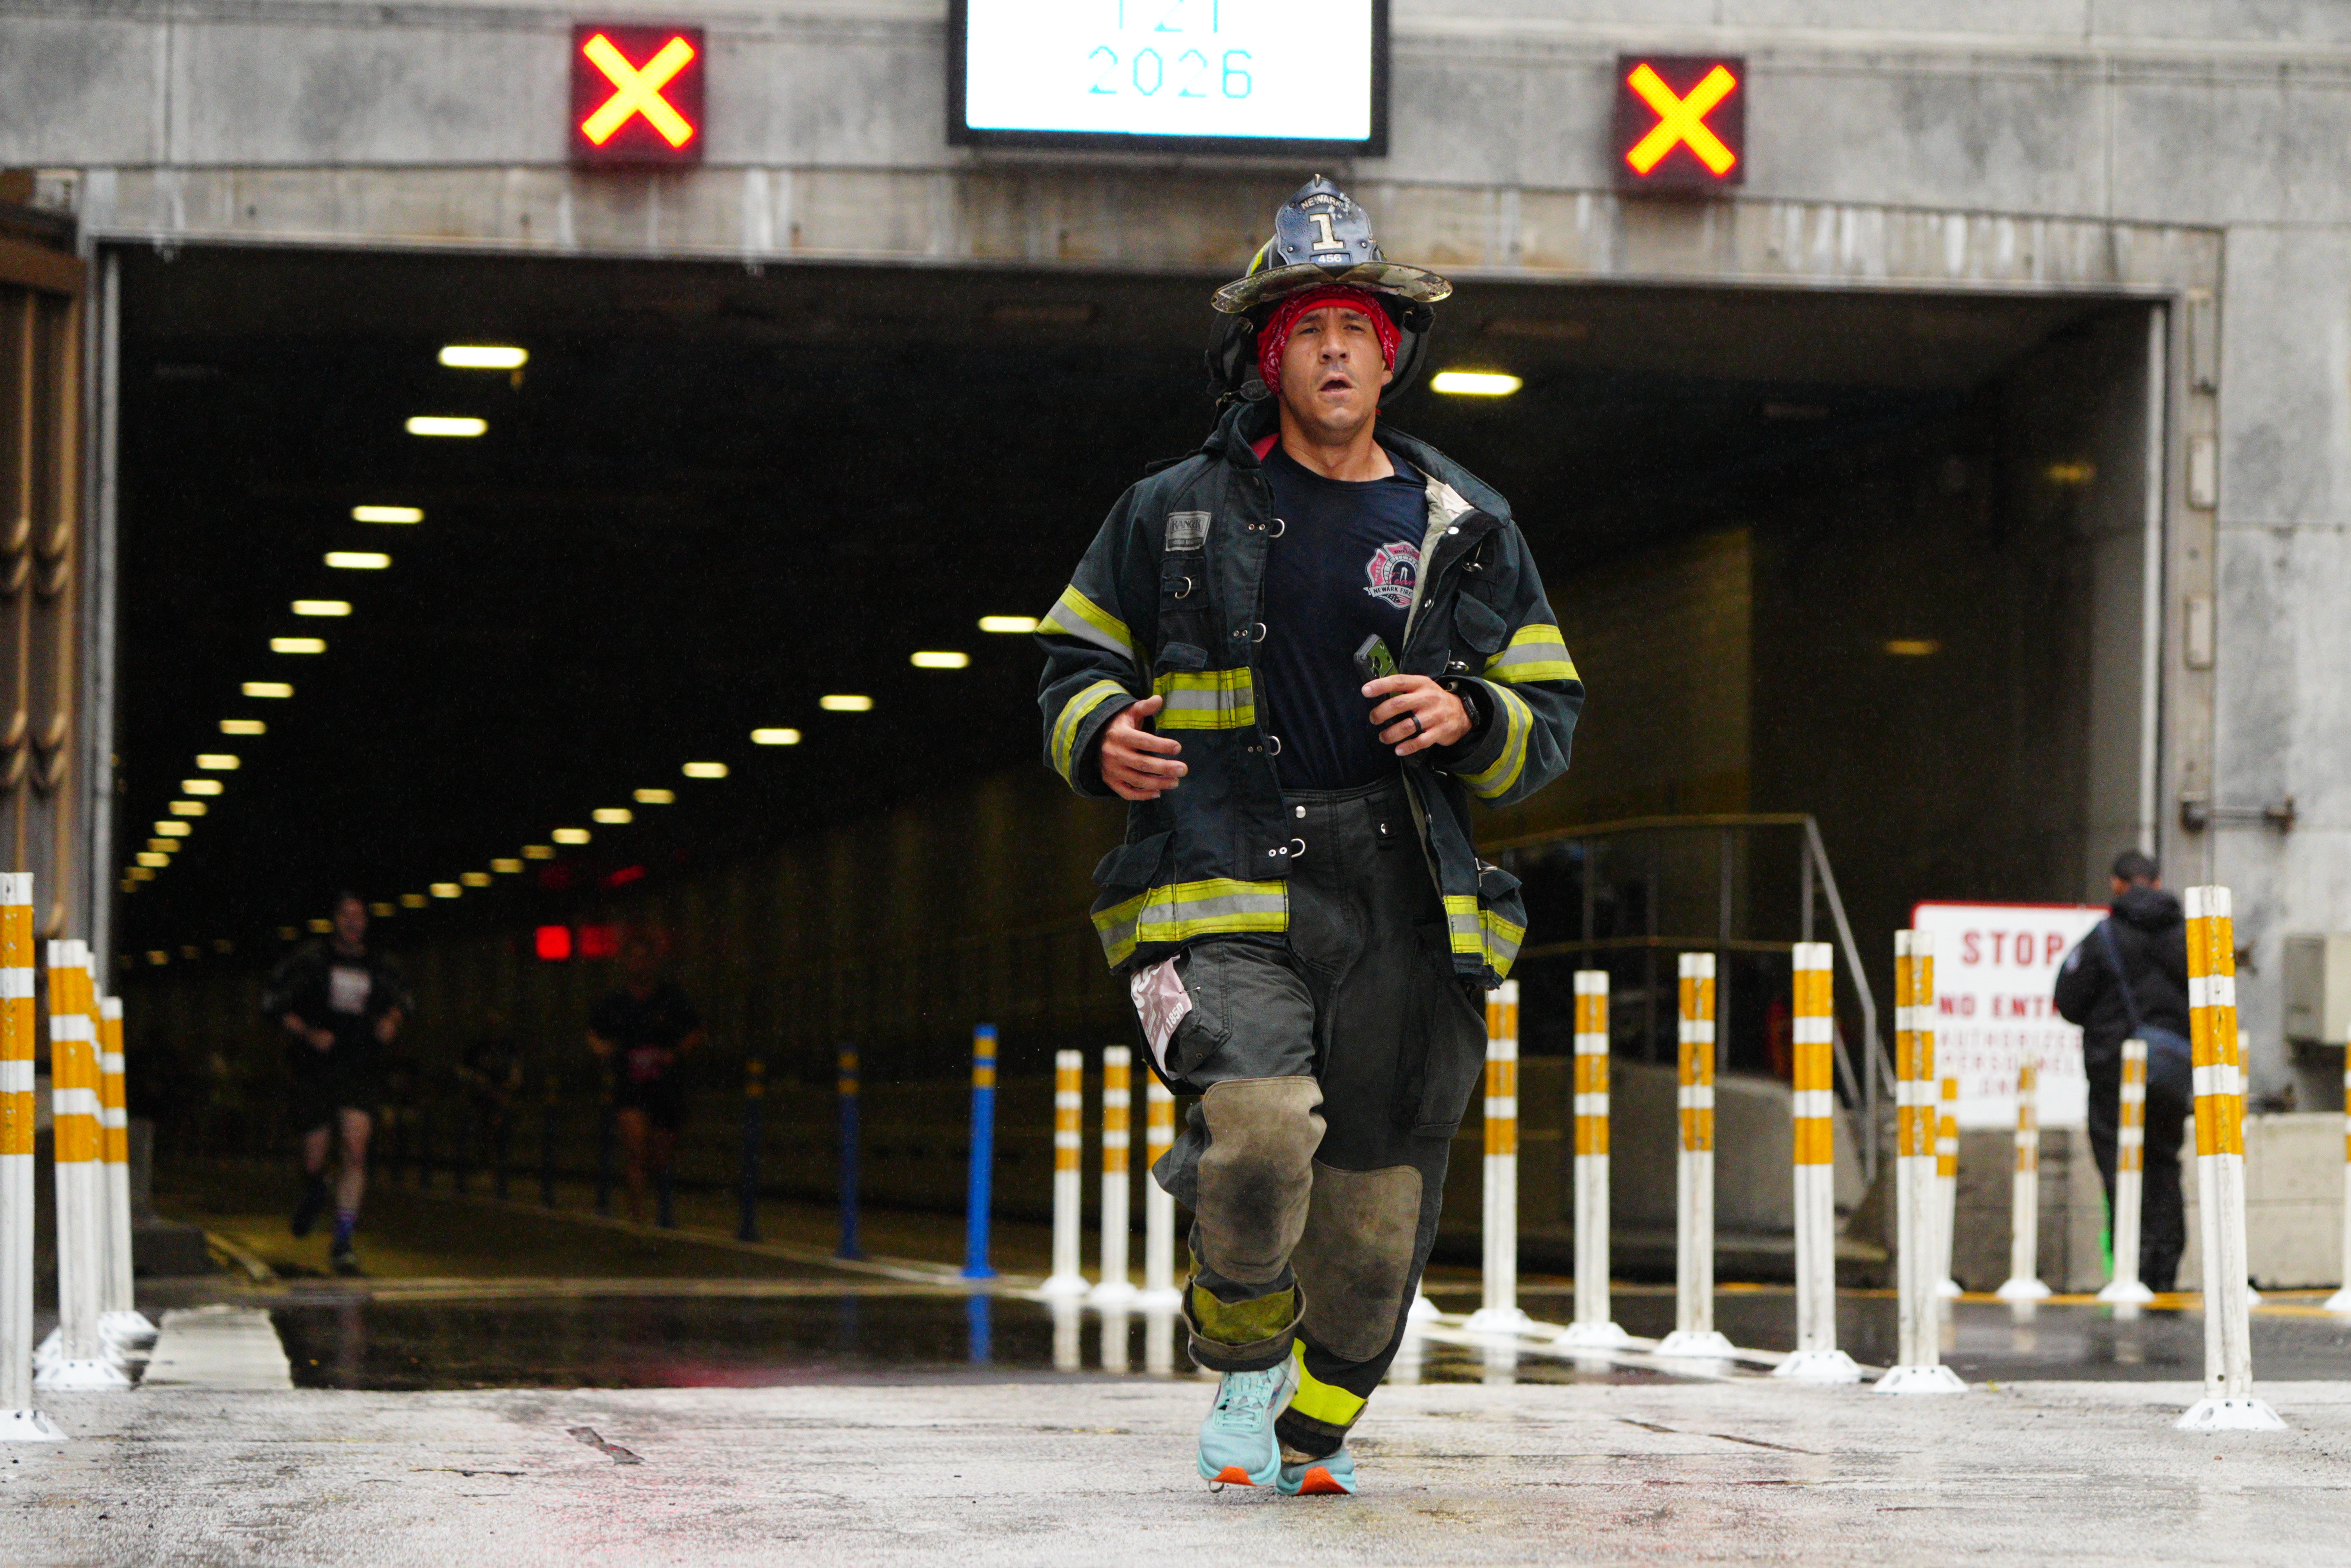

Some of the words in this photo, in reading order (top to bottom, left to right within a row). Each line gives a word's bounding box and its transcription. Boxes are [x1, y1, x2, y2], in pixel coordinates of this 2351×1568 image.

[1088, 45, 1252, 98] 2026
[1309, 213, 1345, 250] 1
[1318, 253, 1342, 263] 456
[1400, 588, 1413, 596] FIRE
[1962, 930, 2065, 966] STOP
[1939, 995, 1975, 1016] NO
